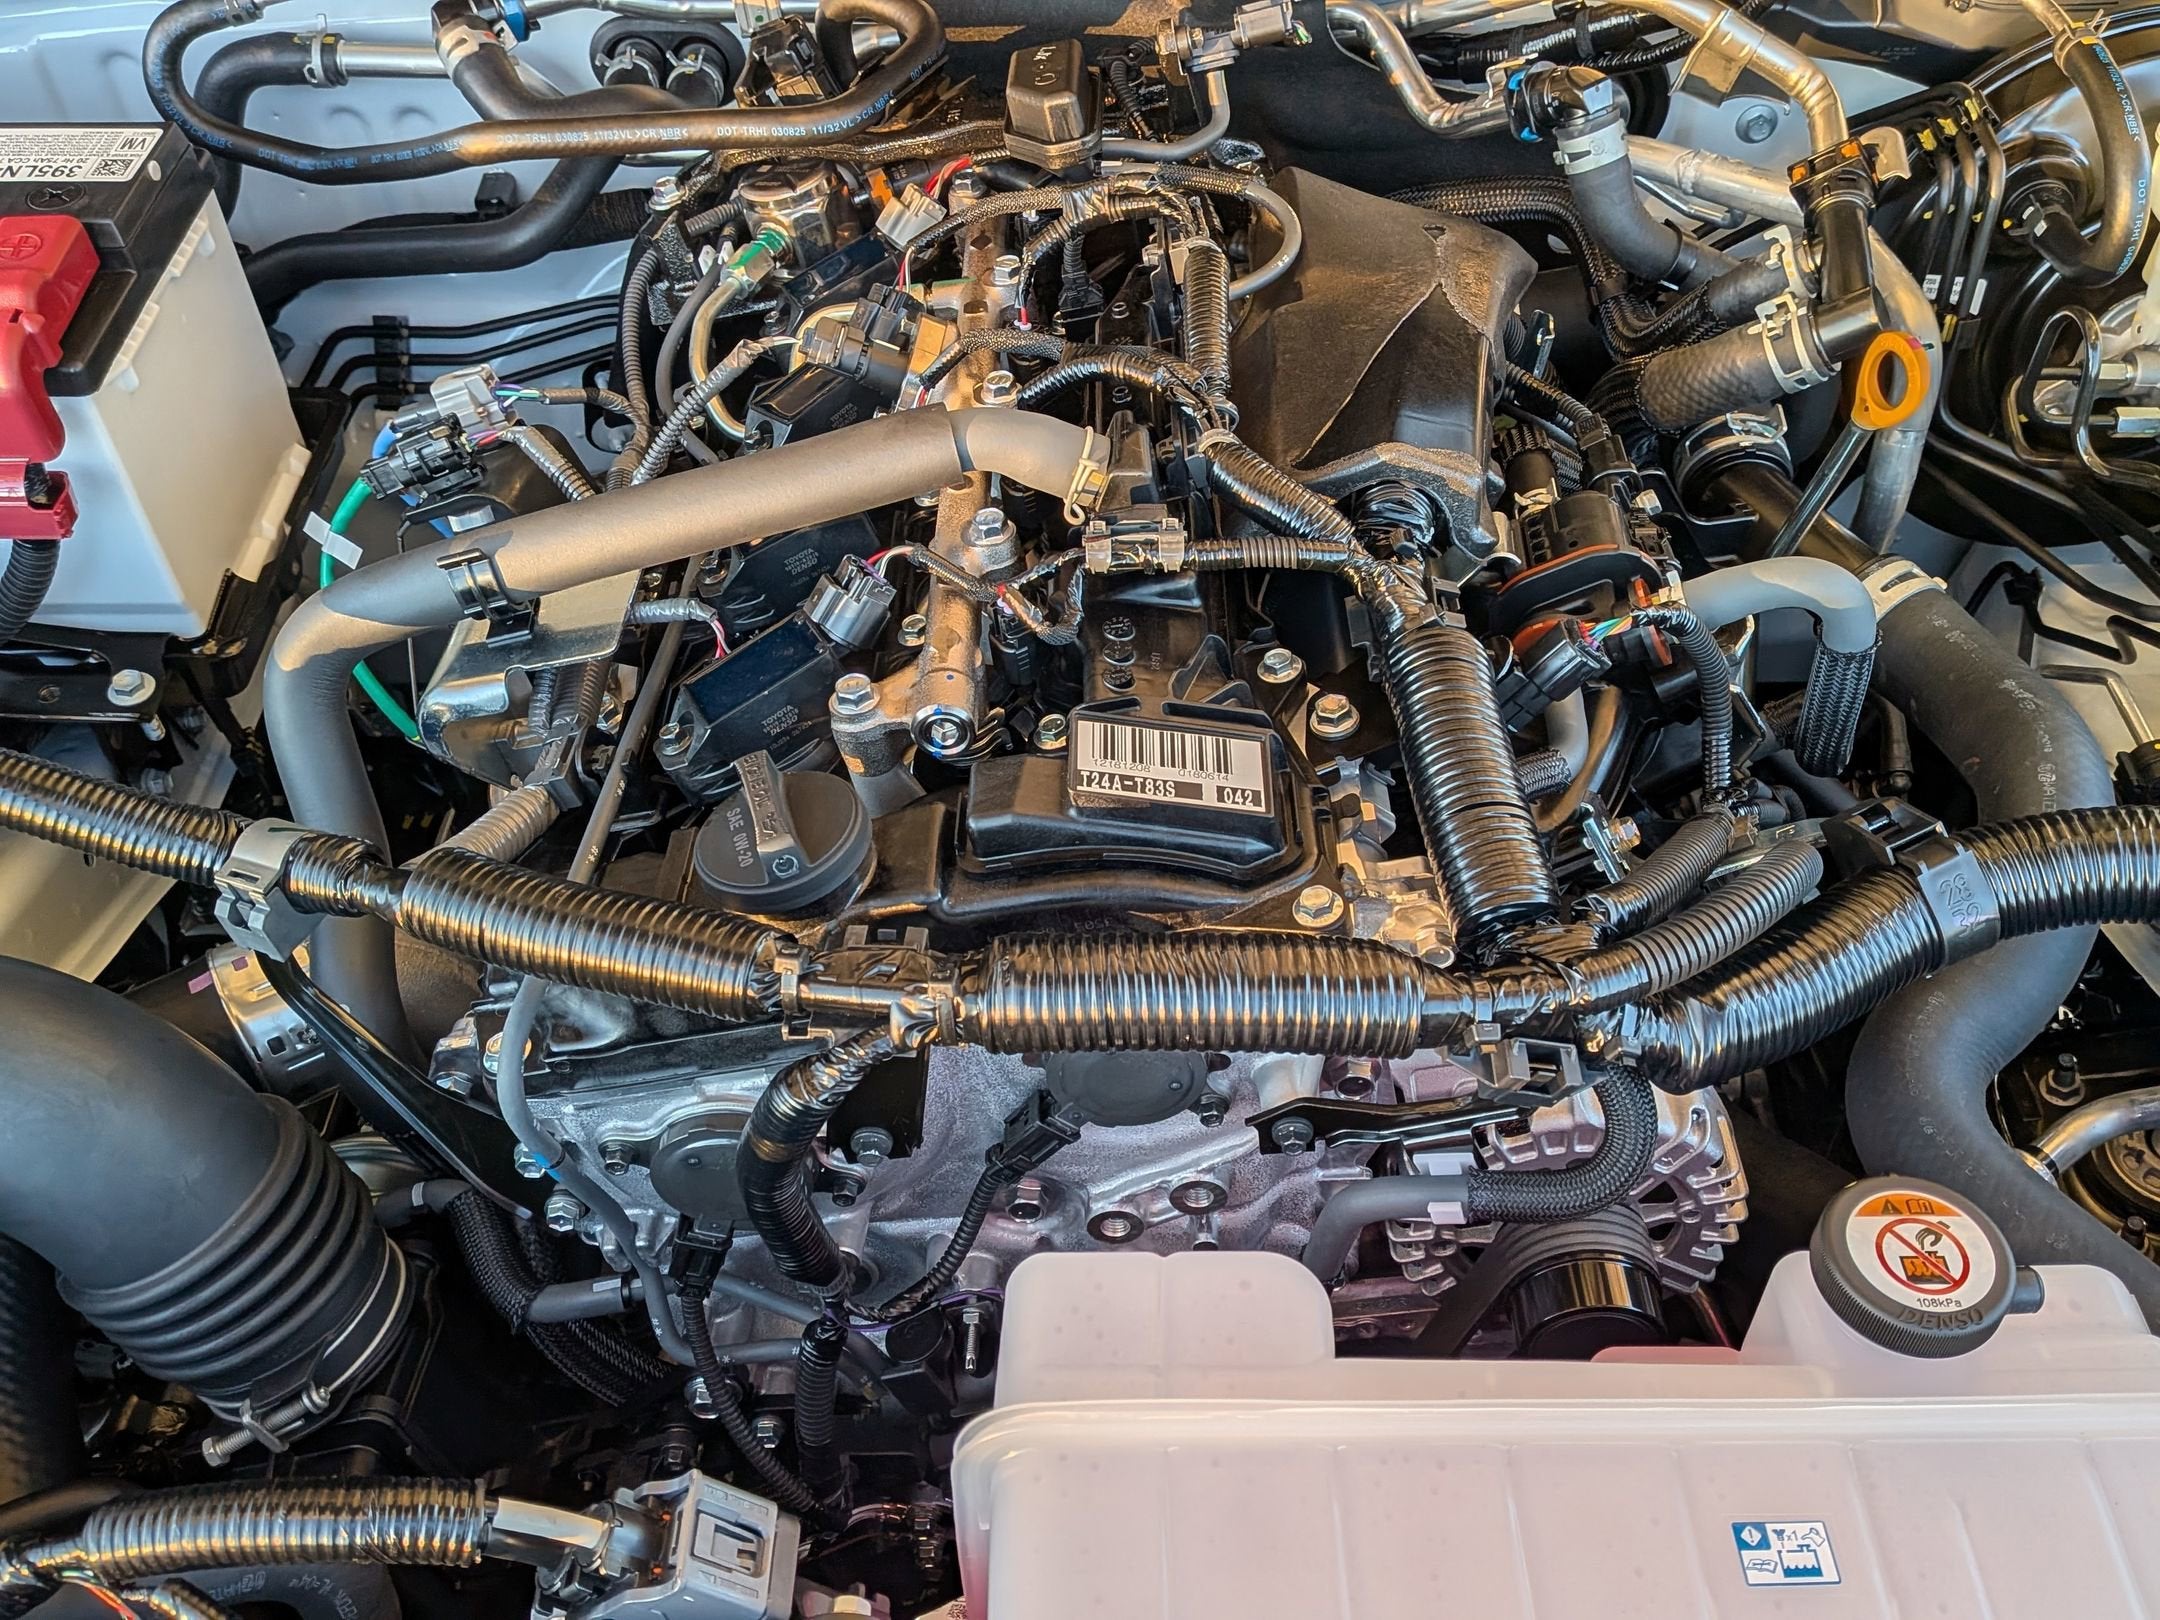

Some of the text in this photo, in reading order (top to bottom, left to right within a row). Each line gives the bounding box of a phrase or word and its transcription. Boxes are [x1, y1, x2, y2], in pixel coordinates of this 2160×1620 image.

[497, 134, 519, 144] DOT
[716, 126, 738, 137] DOT
[771, 126, 806, 137] 030825
[120, 137, 147, 150] VM
[0, 164, 83, 178] 395LN
[2137, 179, 2146, 205] DOT
[783, 547, 814, 565] TOYOTA
[791, 557, 818, 575] DENSO
[761, 704, 794, 727] TOYOTA
[770, 714, 798, 736] DENSO
[1093, 758, 1230, 782] 12181208 0180614
[1080, 771, 1176, 798] T24A-T83S
[1223, 787, 1254, 807] 042
[726, 807, 754, 868] SAE 0W-20
[1916, 1297, 1962, 1309] 108kPa
[1897, 1307, 1985, 1330] DENSO
